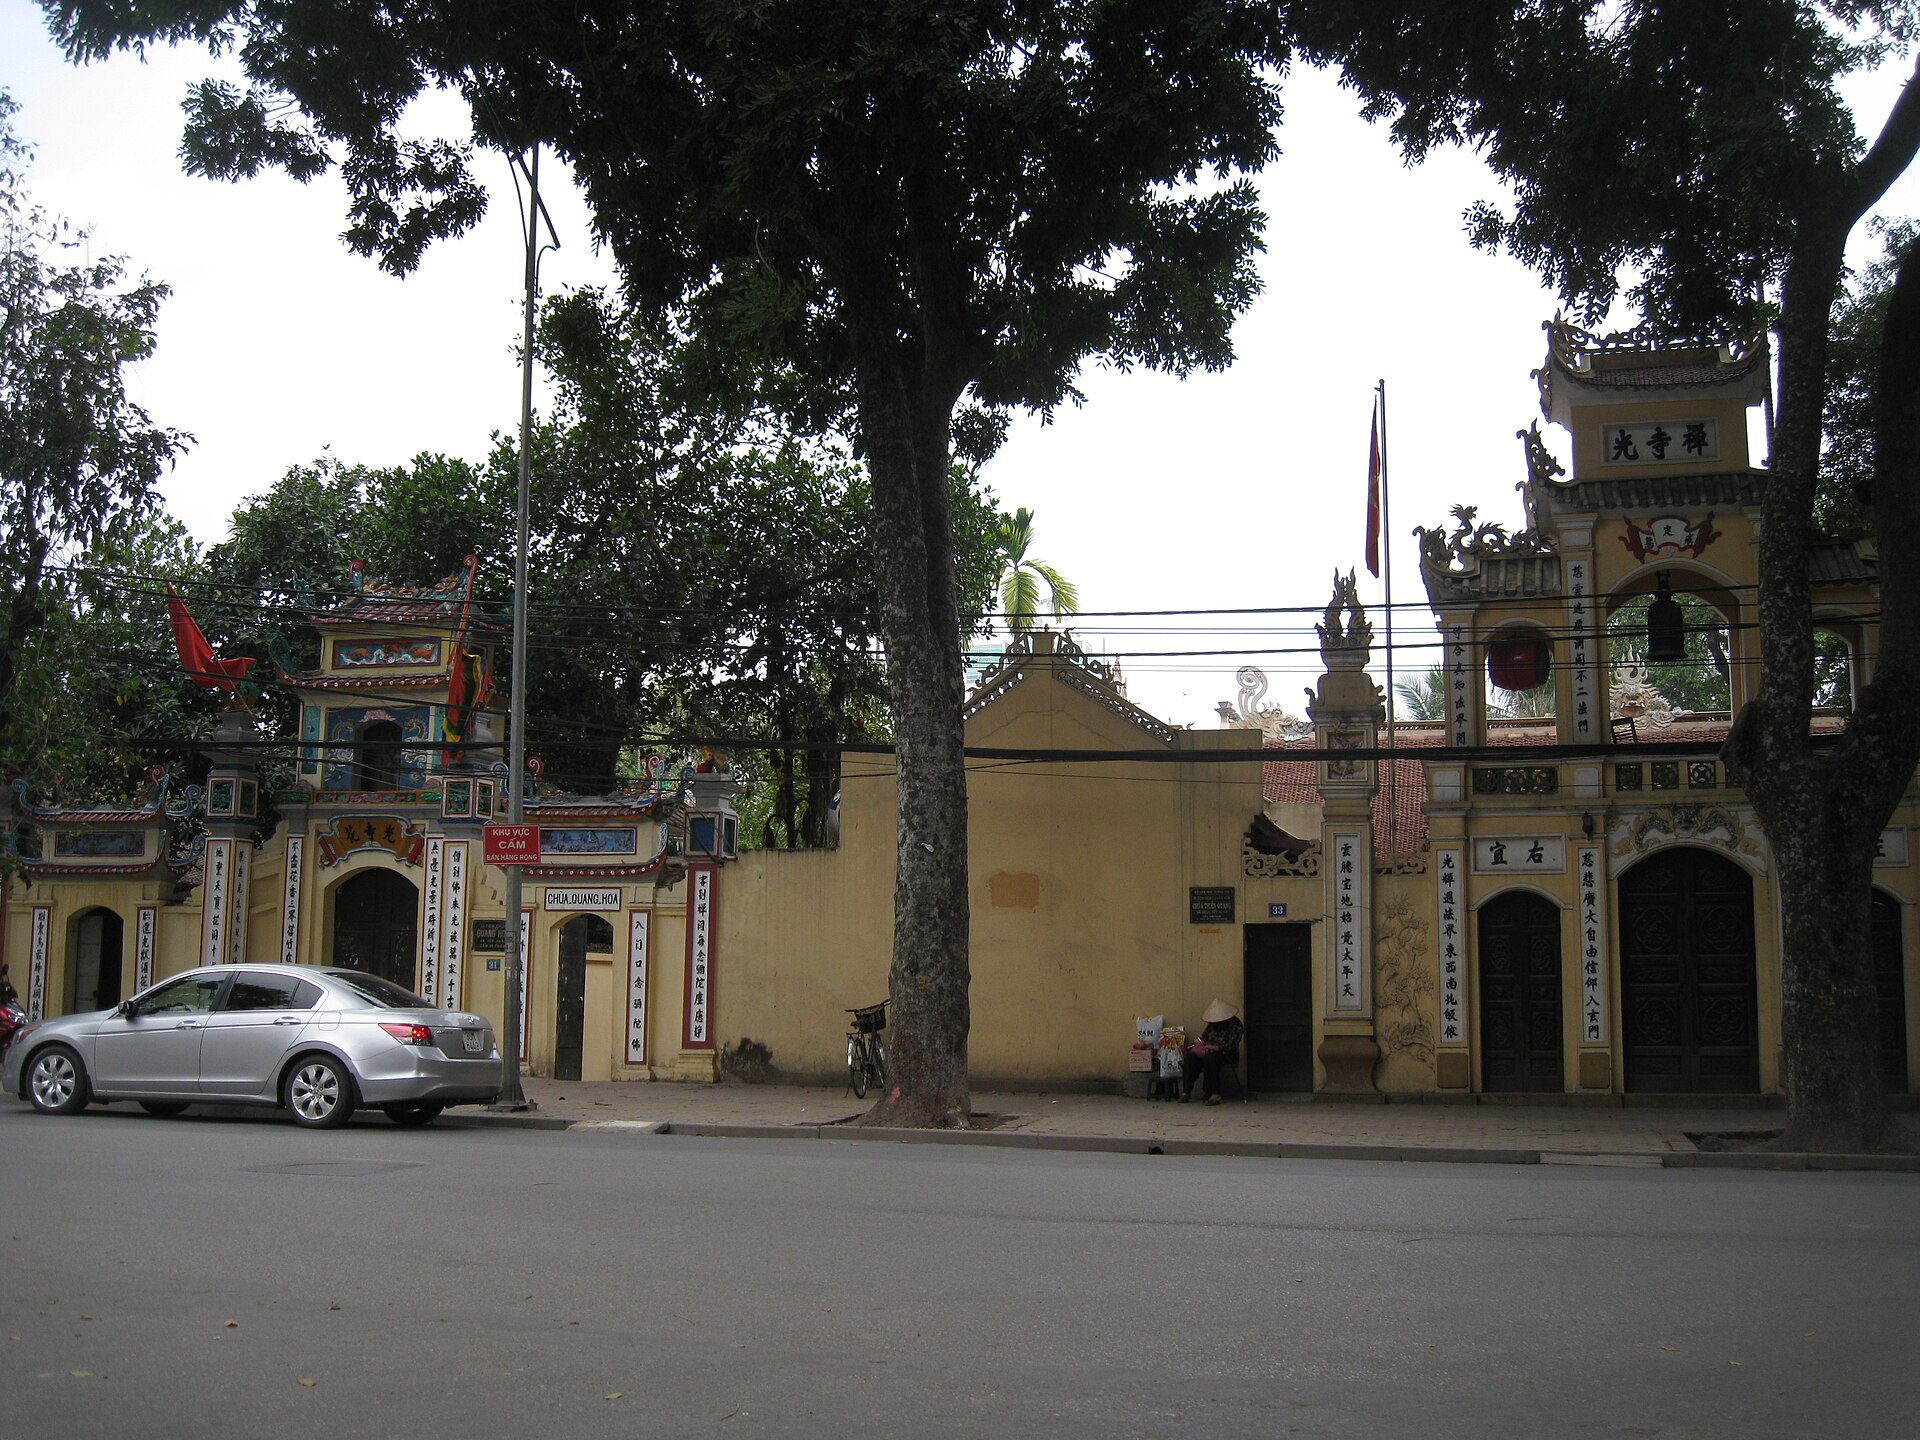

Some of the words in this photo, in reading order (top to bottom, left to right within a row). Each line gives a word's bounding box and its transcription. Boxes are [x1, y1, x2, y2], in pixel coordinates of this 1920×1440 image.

[492, 828, 511, 836] KHU
[498, 837, 526, 849] CẤM
[1271, 905, 1284, 915] 33
[488, 961, 497, 969] 31
